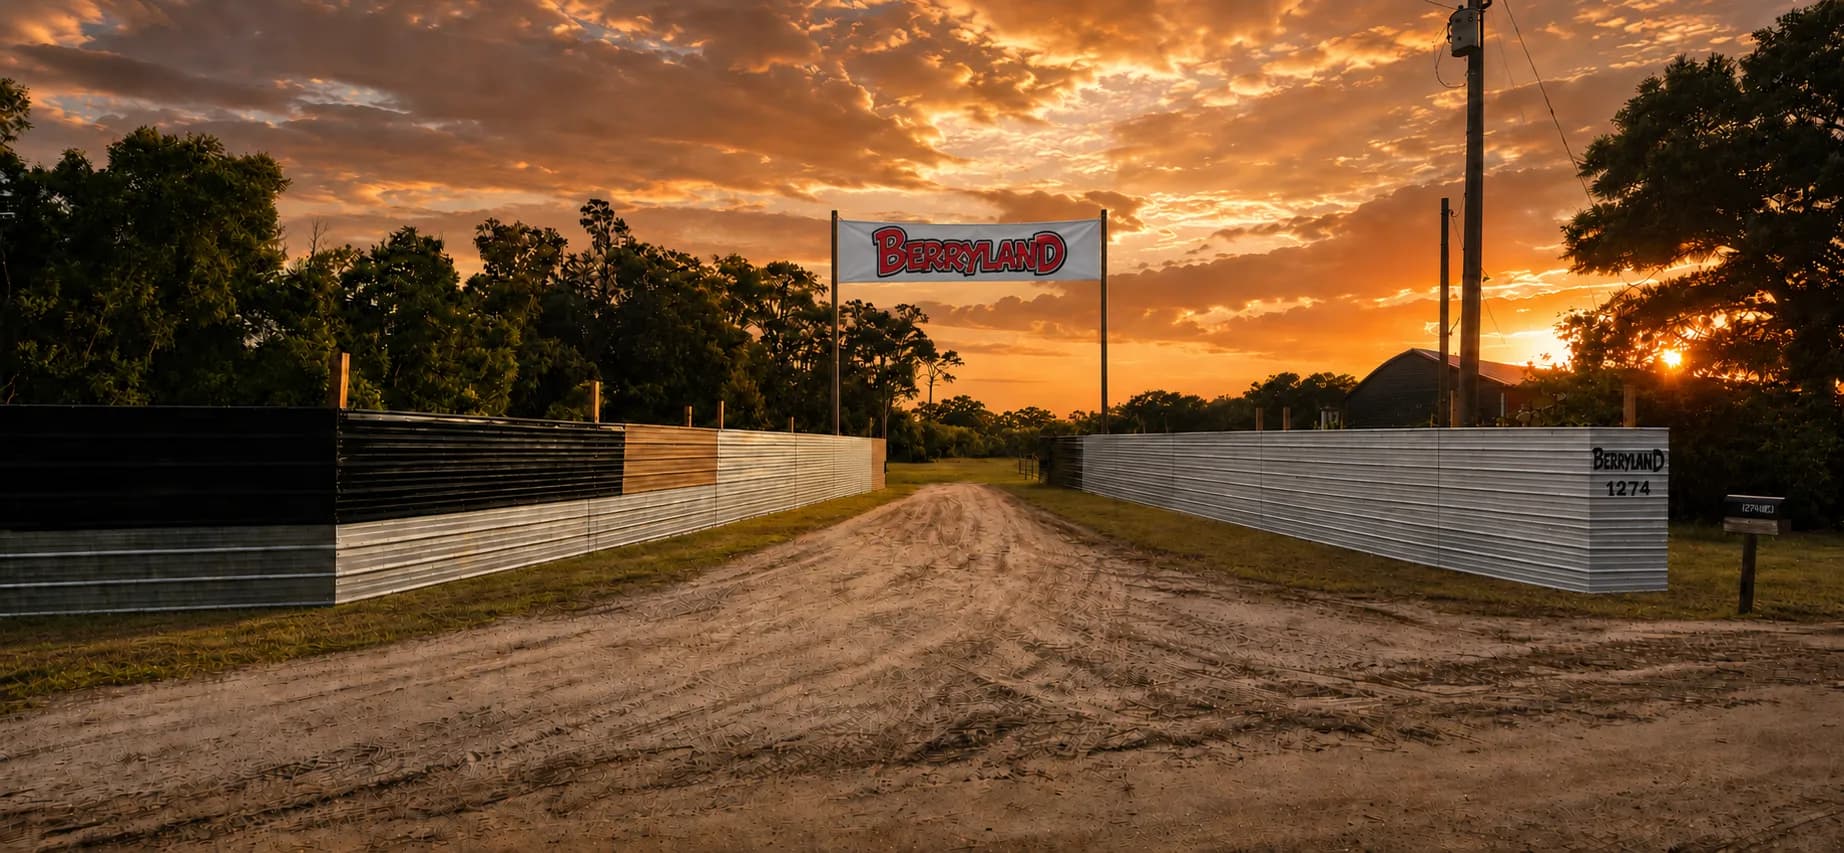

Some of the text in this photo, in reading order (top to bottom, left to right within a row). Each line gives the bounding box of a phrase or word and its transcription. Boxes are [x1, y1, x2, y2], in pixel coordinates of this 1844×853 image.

[872, 226, 1067, 277] BERRYLAND
[1592, 447, 1665, 472] BERRYLAND
[1606, 480, 1650, 496] 1274
